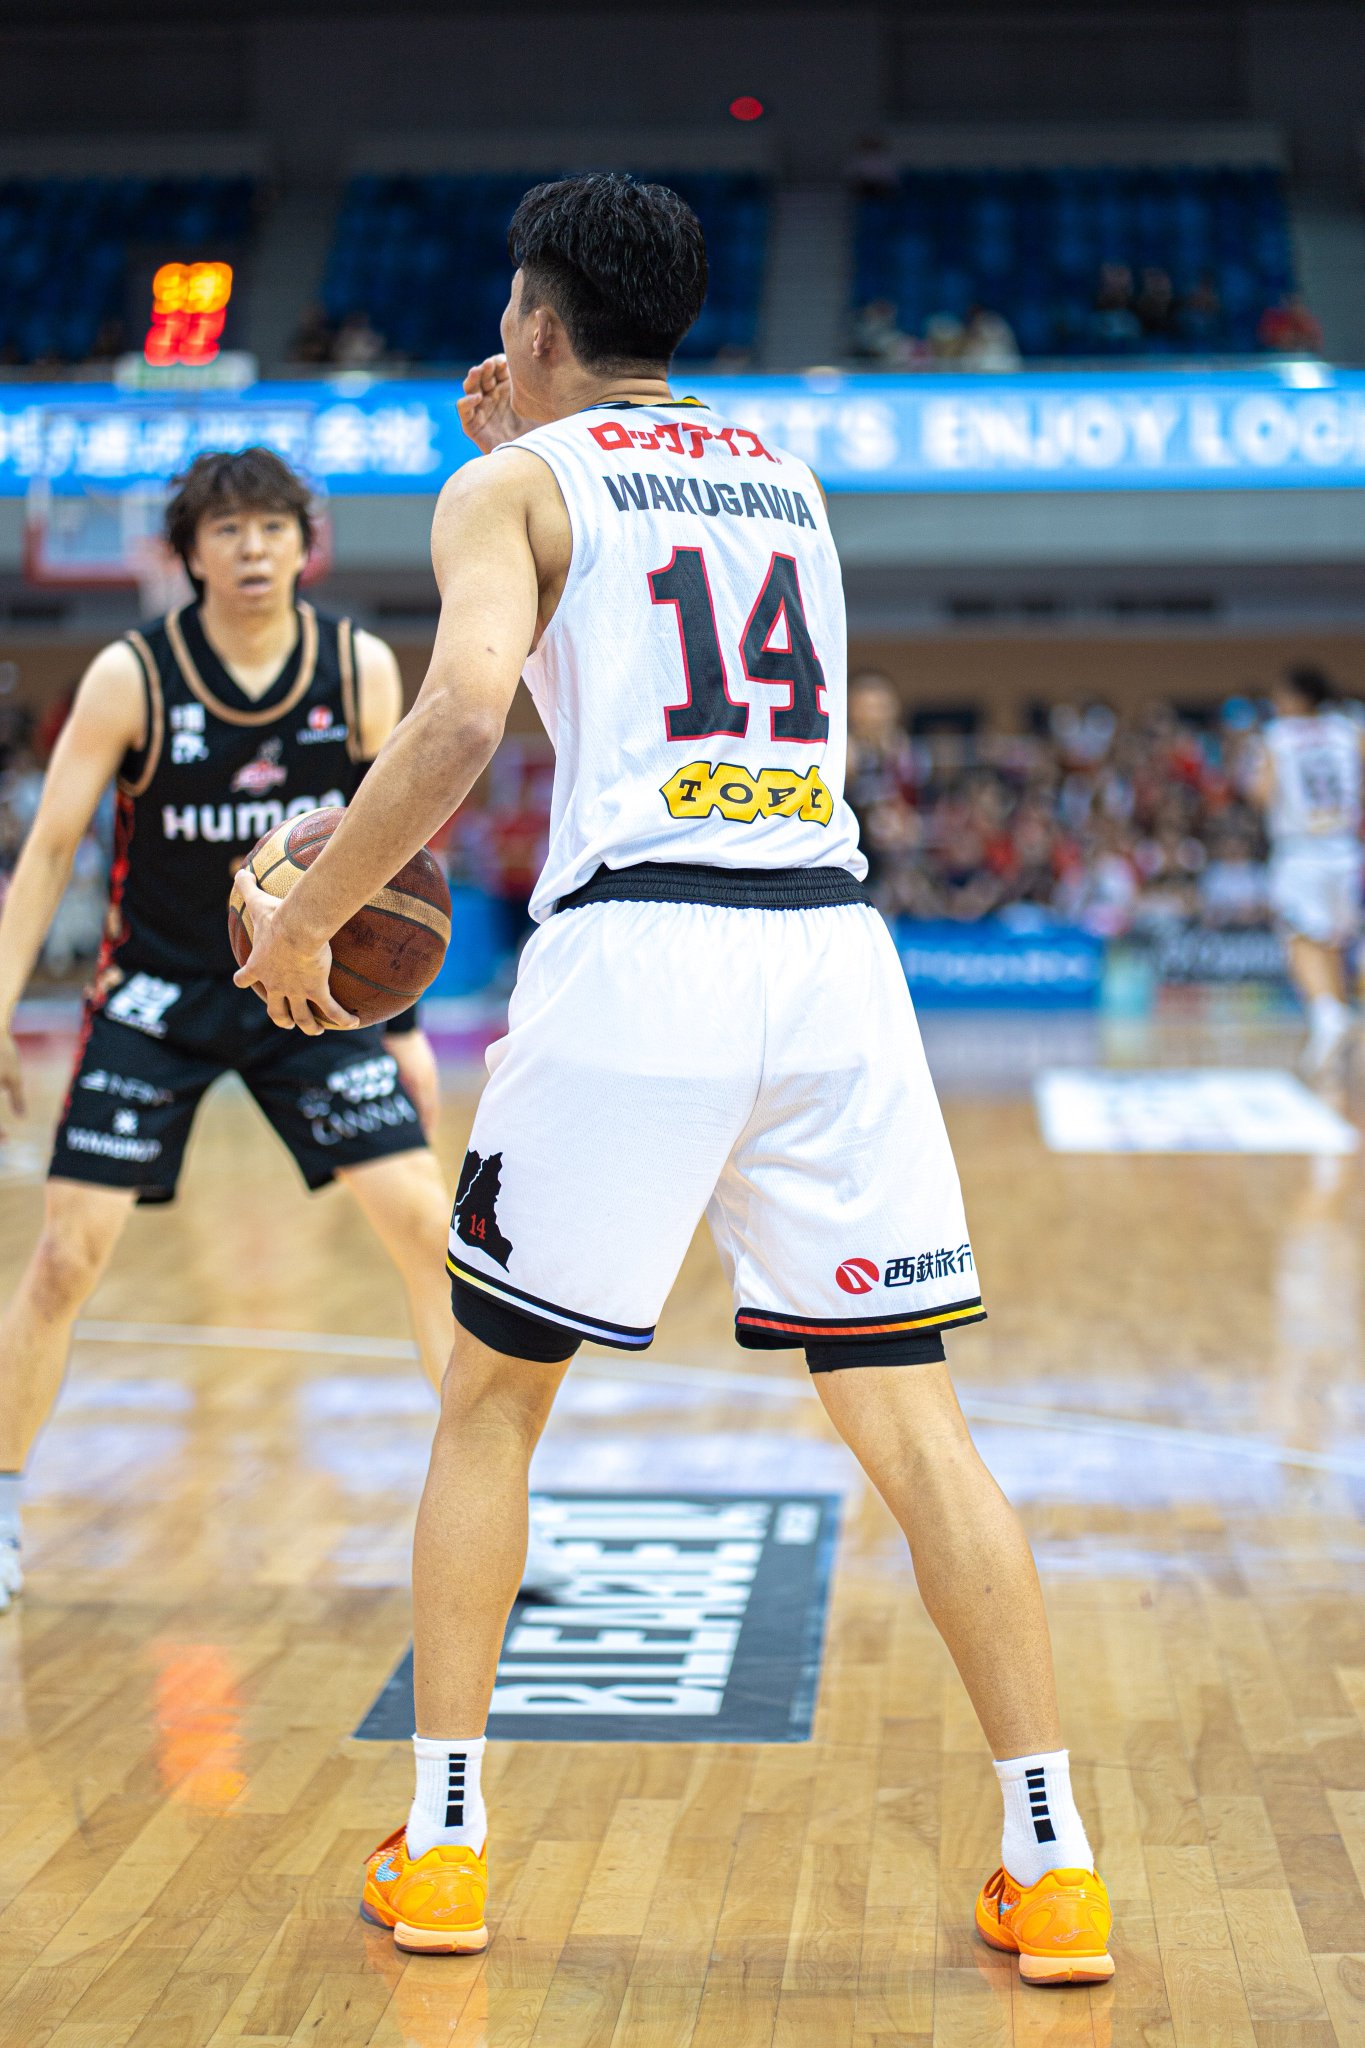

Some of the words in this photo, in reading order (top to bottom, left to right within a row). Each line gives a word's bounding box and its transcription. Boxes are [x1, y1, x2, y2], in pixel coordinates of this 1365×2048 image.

[587, 421, 777, 464] ロックアイス
[922, 401, 1177, 470] ENJOY
[602, 472, 818, 531] WAKUGAWA
[646, 545, 830, 746] 14
[469, 1213, 486, 1240] 14
[884, 1243, 973, 1287] 西鉄旅行
